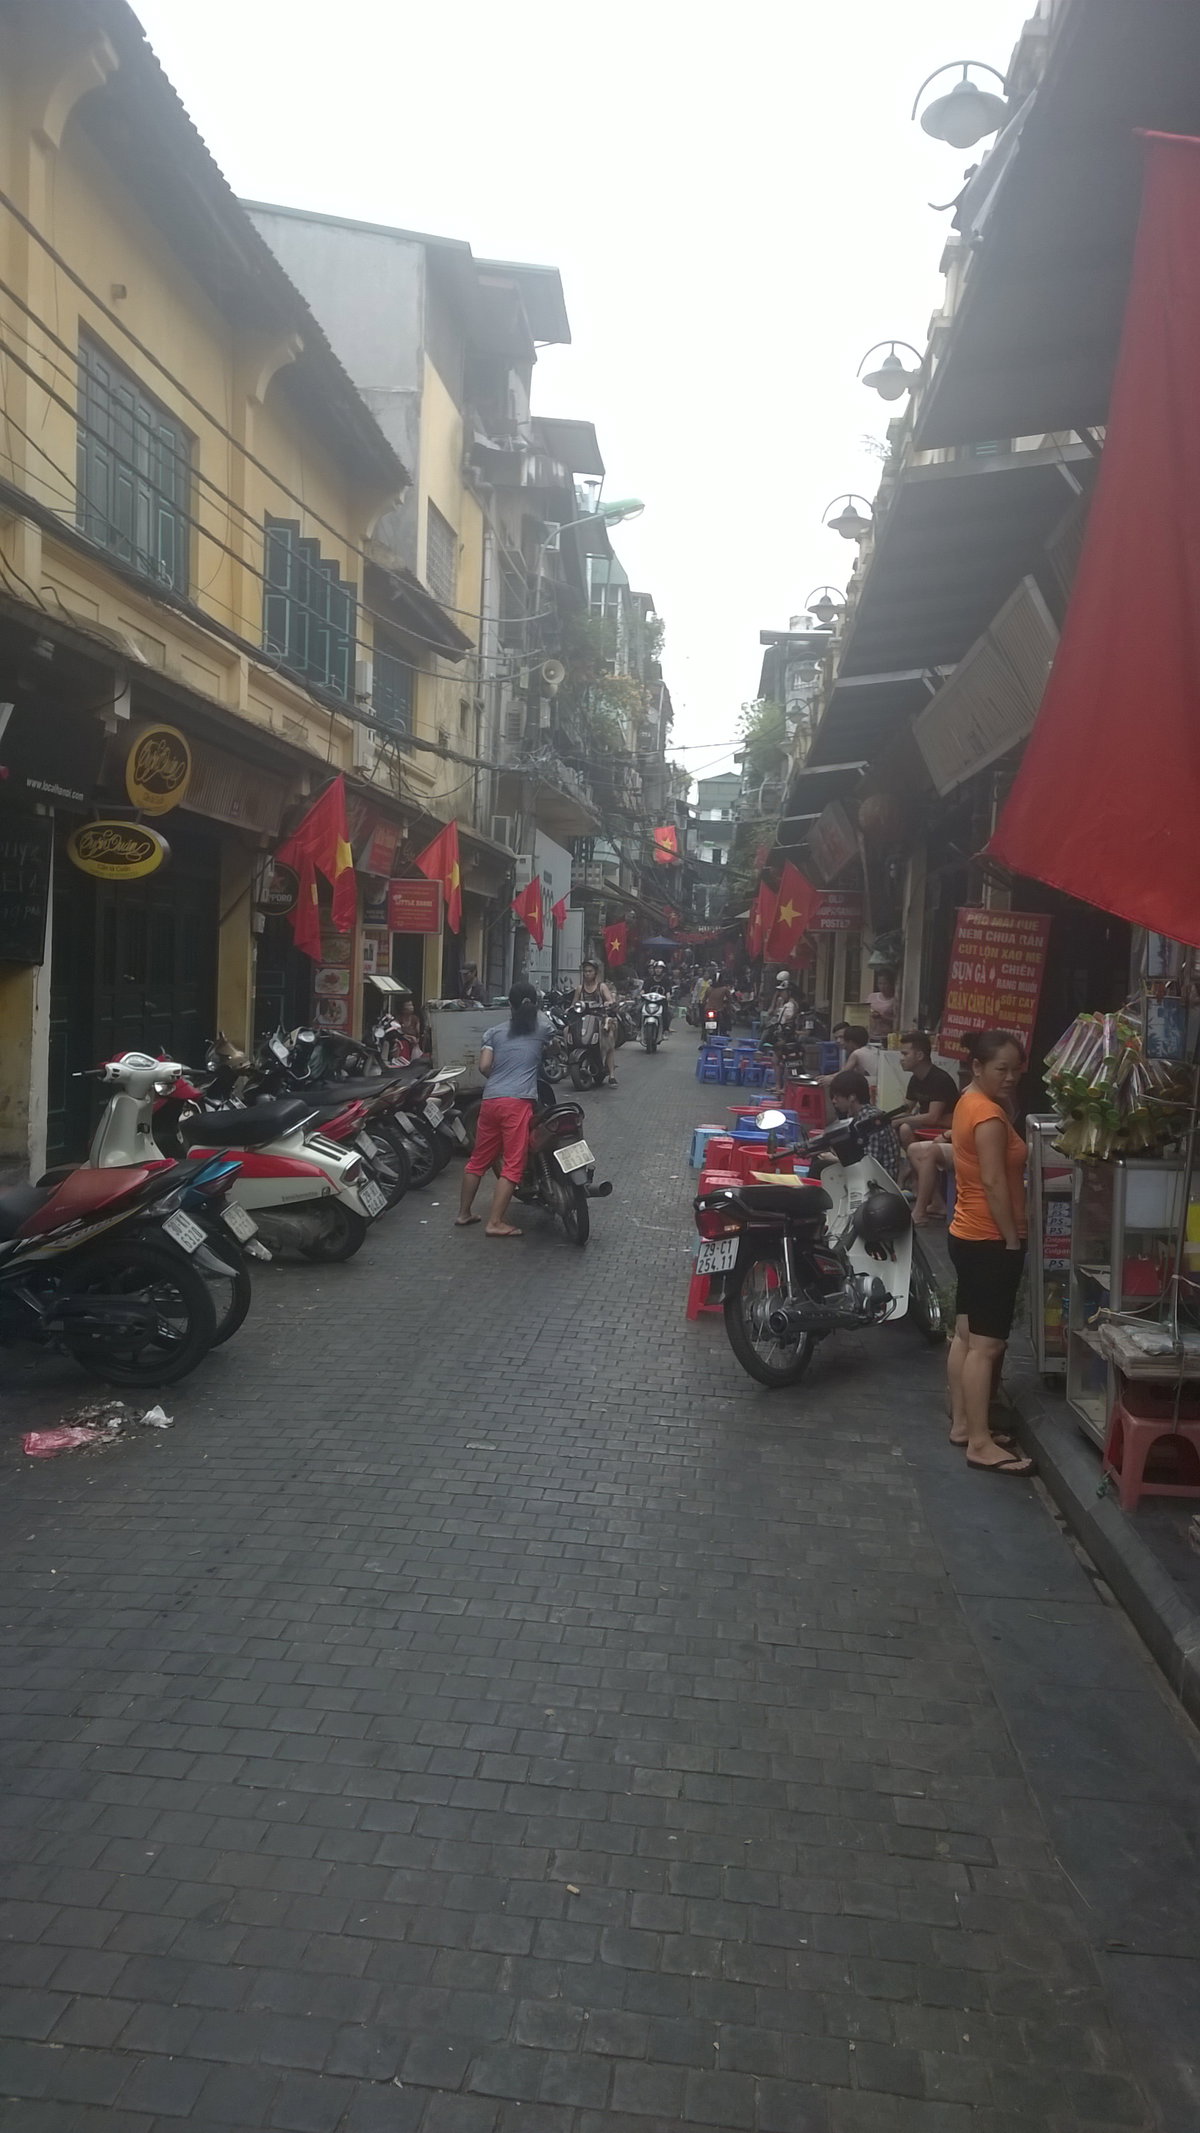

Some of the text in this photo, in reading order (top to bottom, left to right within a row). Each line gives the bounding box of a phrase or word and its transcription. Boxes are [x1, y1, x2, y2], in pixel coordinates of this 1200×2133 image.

[942, 1027, 967, 1039] KHOA
[1050, 1217, 1063, 1226] PS
[1049, 1227, 1063, 1236] PS
[698, 1254, 733, 1273] 254.11
[1048, 1259, 1064, 1270] PS
